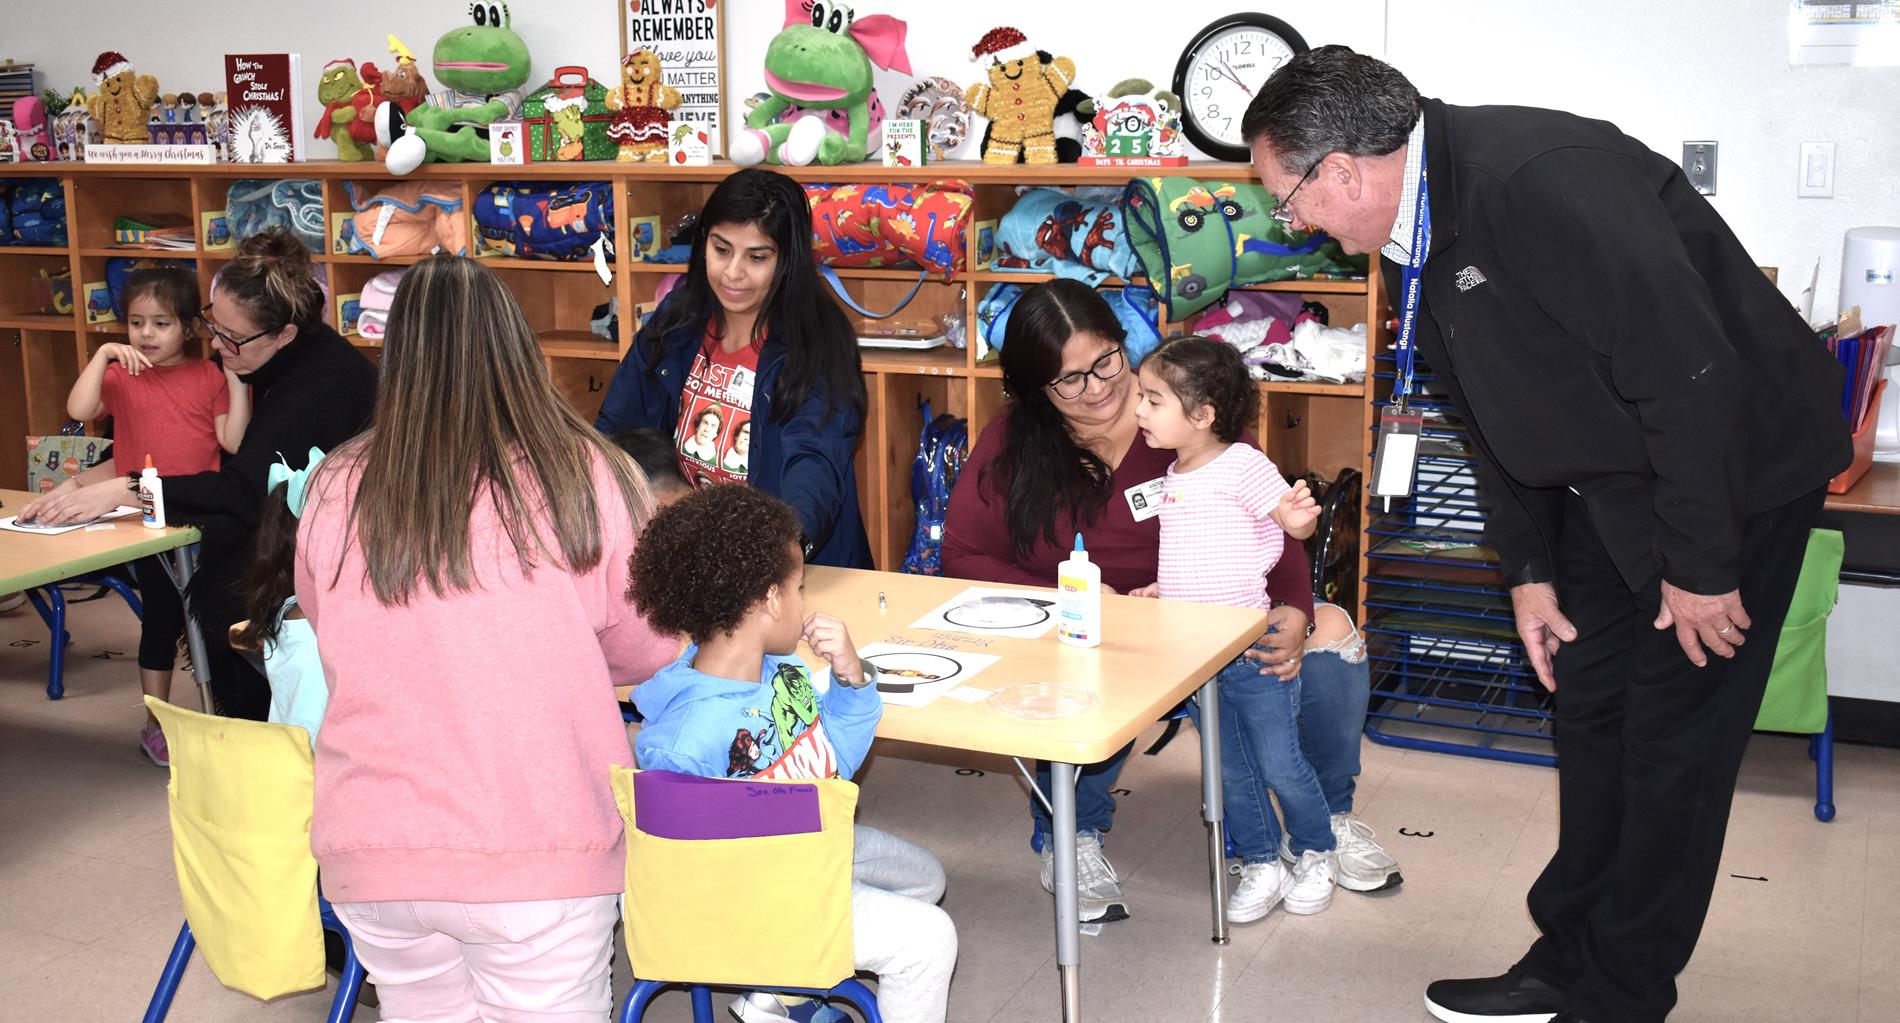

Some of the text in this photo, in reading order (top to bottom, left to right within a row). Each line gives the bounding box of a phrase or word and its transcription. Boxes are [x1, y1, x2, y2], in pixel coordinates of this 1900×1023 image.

[641, 0, 704, 15] ALWAYS
[632, 16, 714, 42] REMEMBER
[1233, 40, 1252, 56] 12
[1260, 43, 1265, 57] 1
[685, 50, 716, 68] you
[1219, 49, 1230, 64] 11
[667, 72, 717, 85] MATTER
[1204, 66, 1222, 81] 10
[1201, 86, 1213, 100] 9
[1206, 104, 1220, 119] 8
[1222, 116, 1233, 131] 7
[118, 150, 132, 162] you
[164, 146, 205, 160] Christmas
[1126, 158, 1161, 166] CHRISTMAS
[1399, 310, 1414, 350] Mustangs
[704, 385, 722, 399] ME
